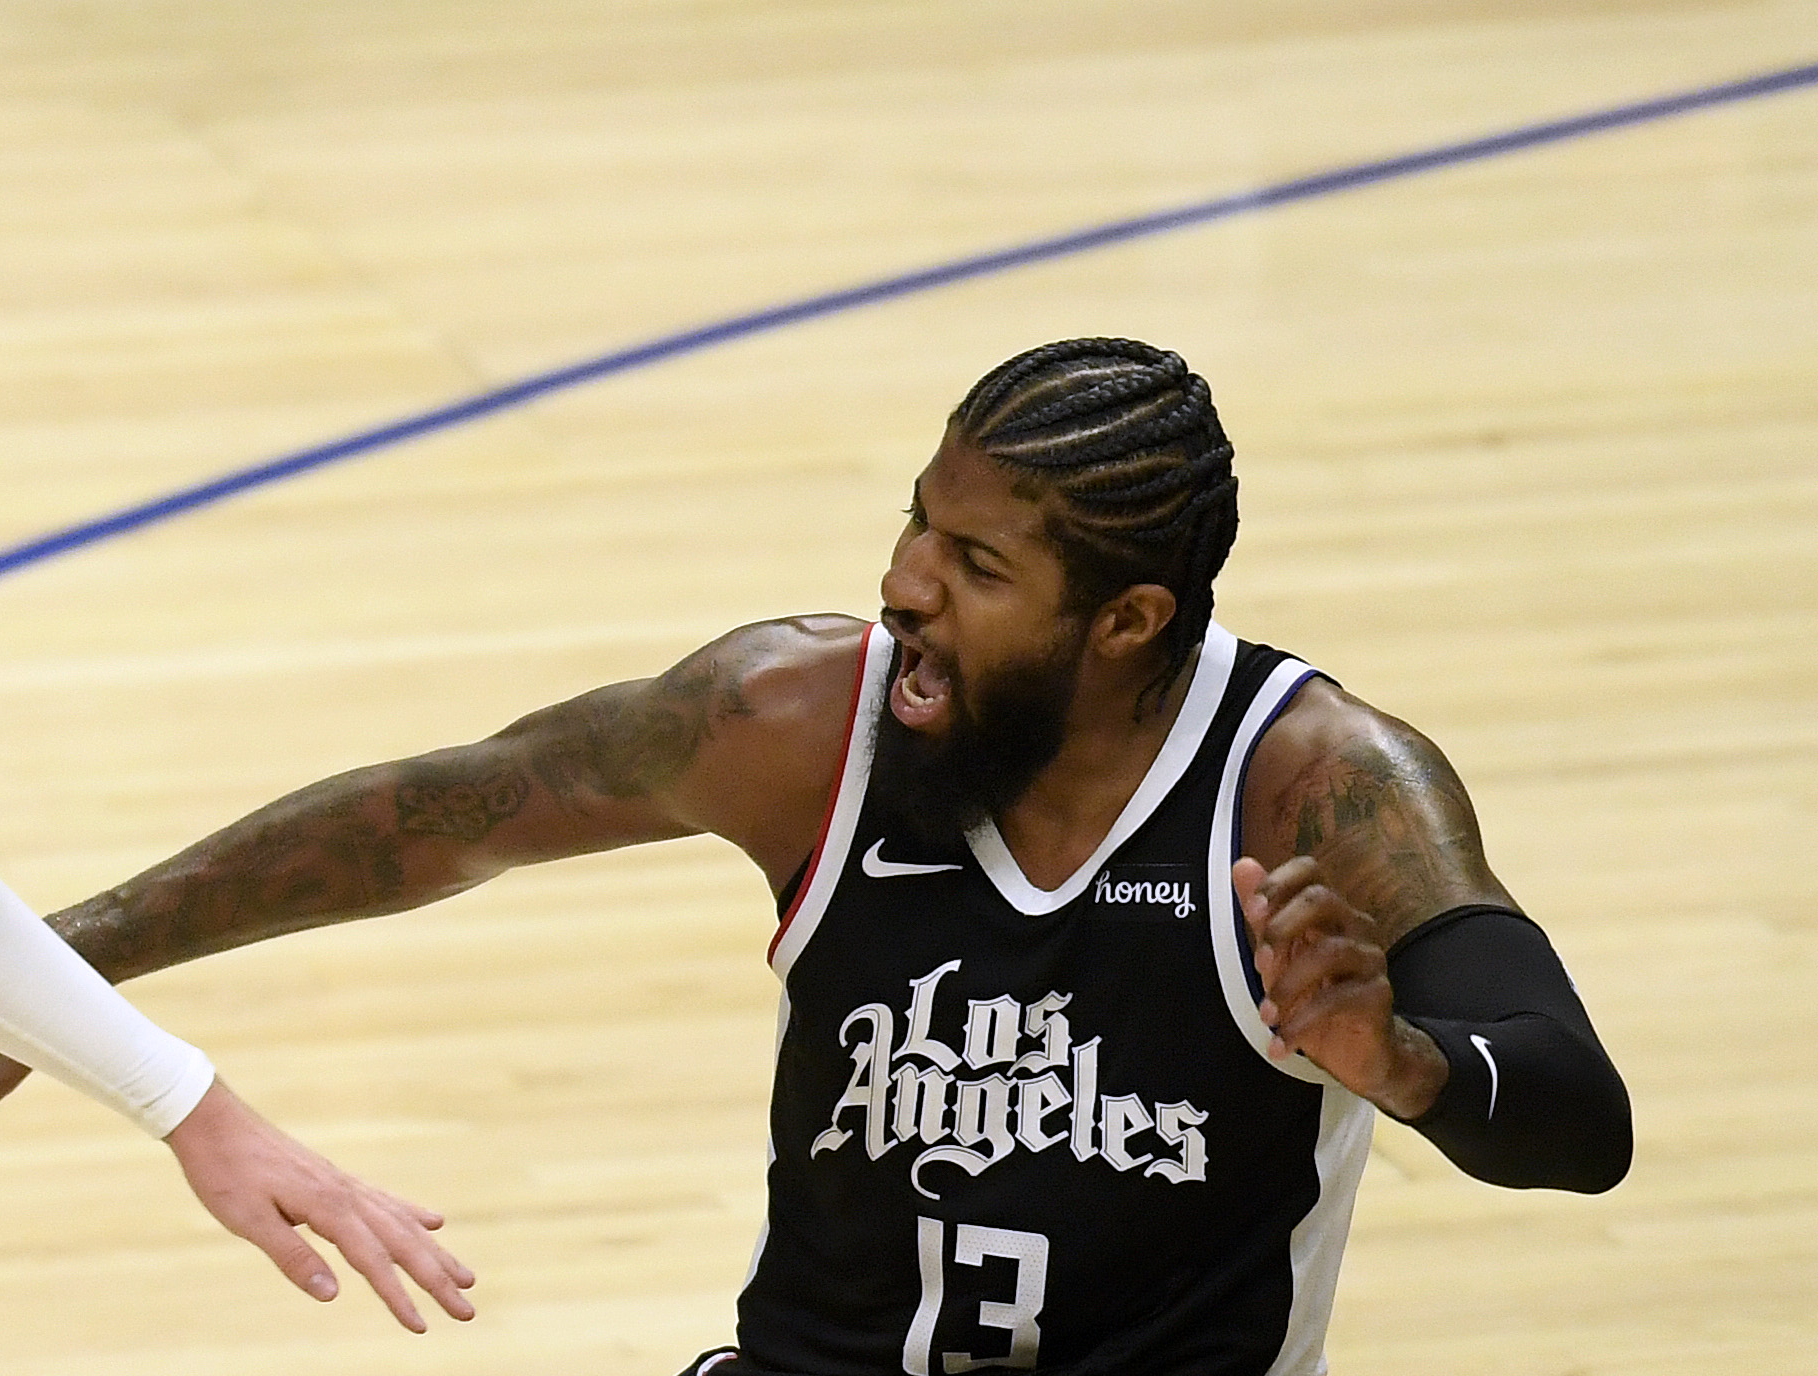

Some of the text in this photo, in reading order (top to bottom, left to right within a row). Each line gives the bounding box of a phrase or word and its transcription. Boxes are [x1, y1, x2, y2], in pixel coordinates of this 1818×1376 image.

[1093, 869, 1197, 919] honey
[892, 958, 1073, 1076] Los
[810, 1002, 1210, 1201] Angeles
